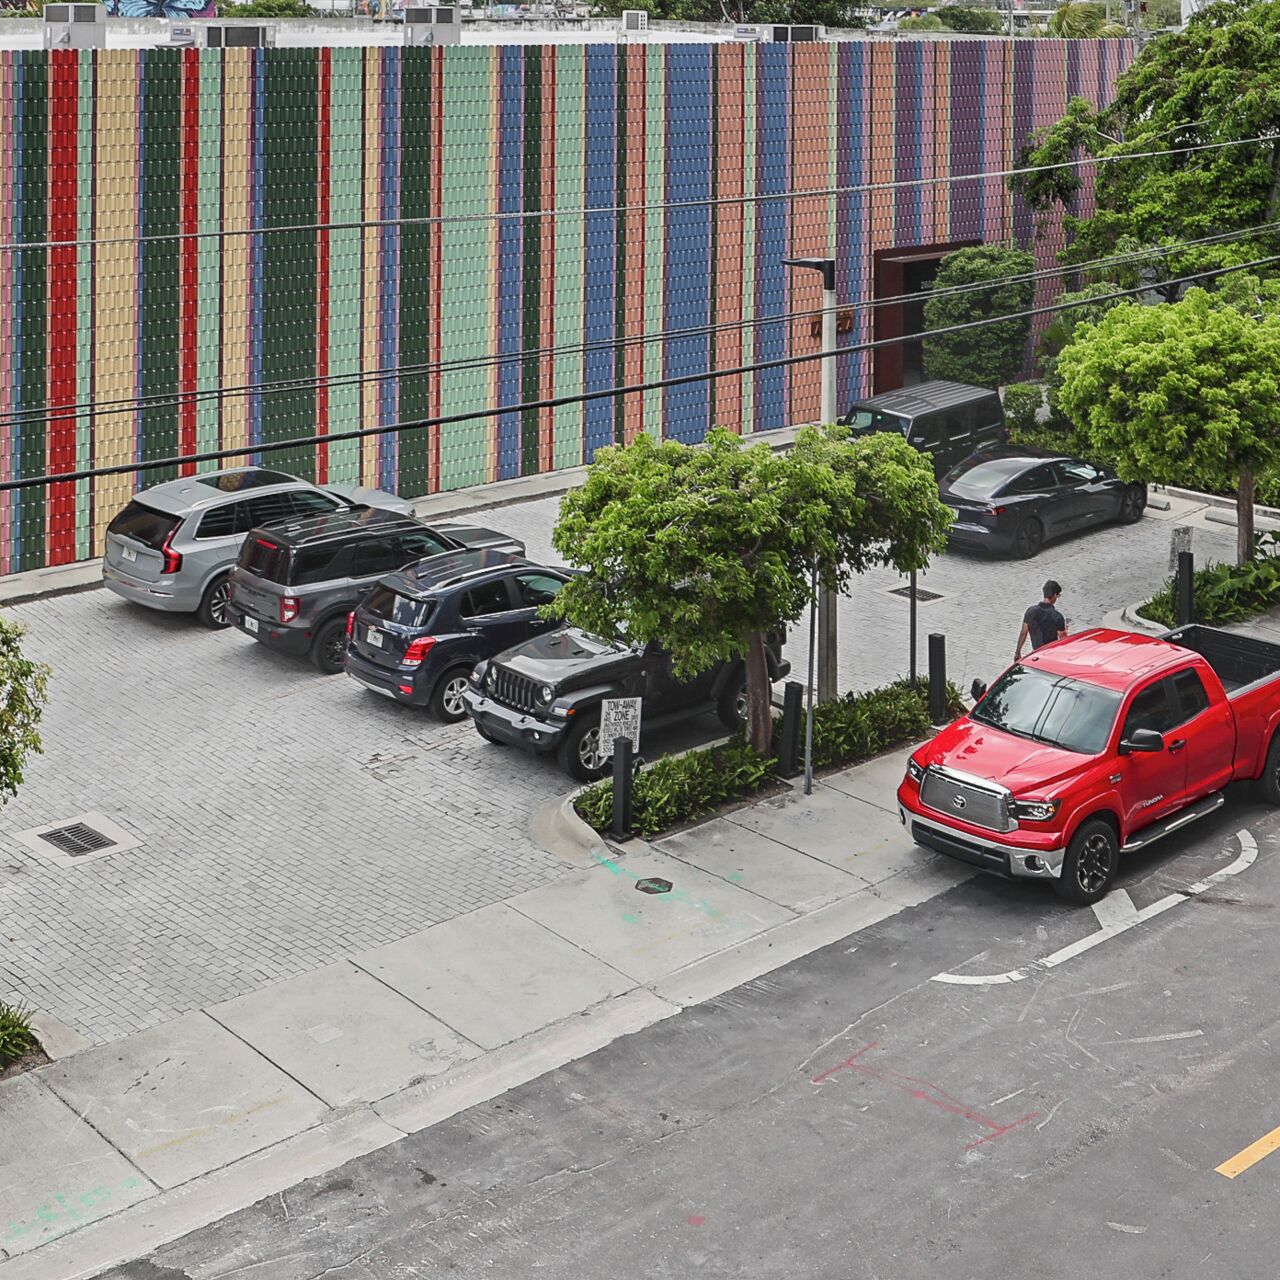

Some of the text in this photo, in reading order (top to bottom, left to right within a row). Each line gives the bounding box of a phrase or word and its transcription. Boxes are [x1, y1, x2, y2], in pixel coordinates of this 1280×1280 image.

[607, 699, 637, 711] TOW-AWAY
[613, 710, 630, 721] ZONE
[1142, 794, 1164, 807] TUNDRA
